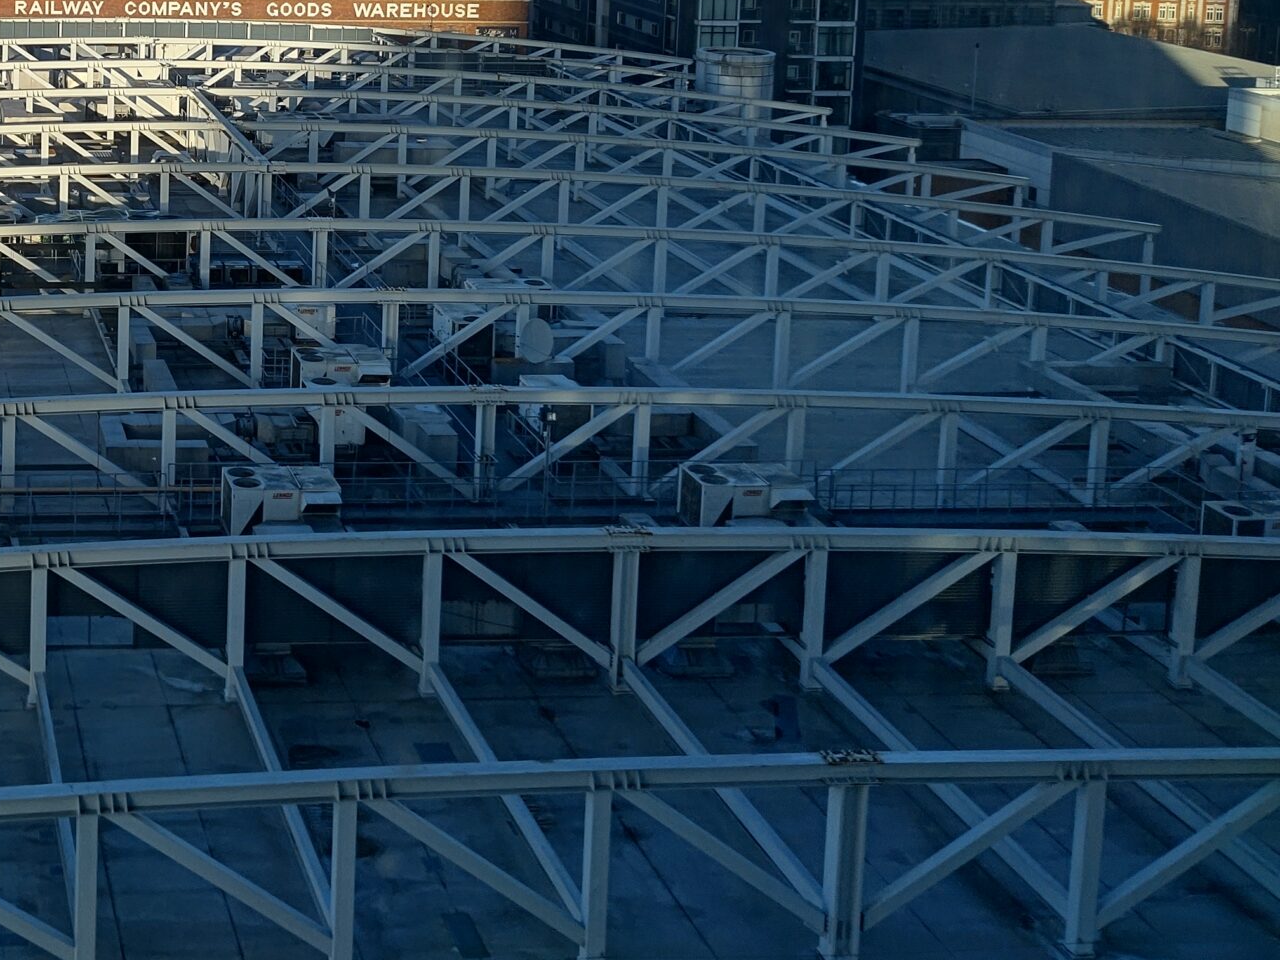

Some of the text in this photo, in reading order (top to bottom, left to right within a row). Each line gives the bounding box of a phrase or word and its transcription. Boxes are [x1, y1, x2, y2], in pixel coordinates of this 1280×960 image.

[14, 0, 105, 16] RAILWAY
[124, 0, 243, 17] COMPANY'S
[266, 1, 333, 18] GOODS
[352, 2, 480, 19] WAREHOUSE
